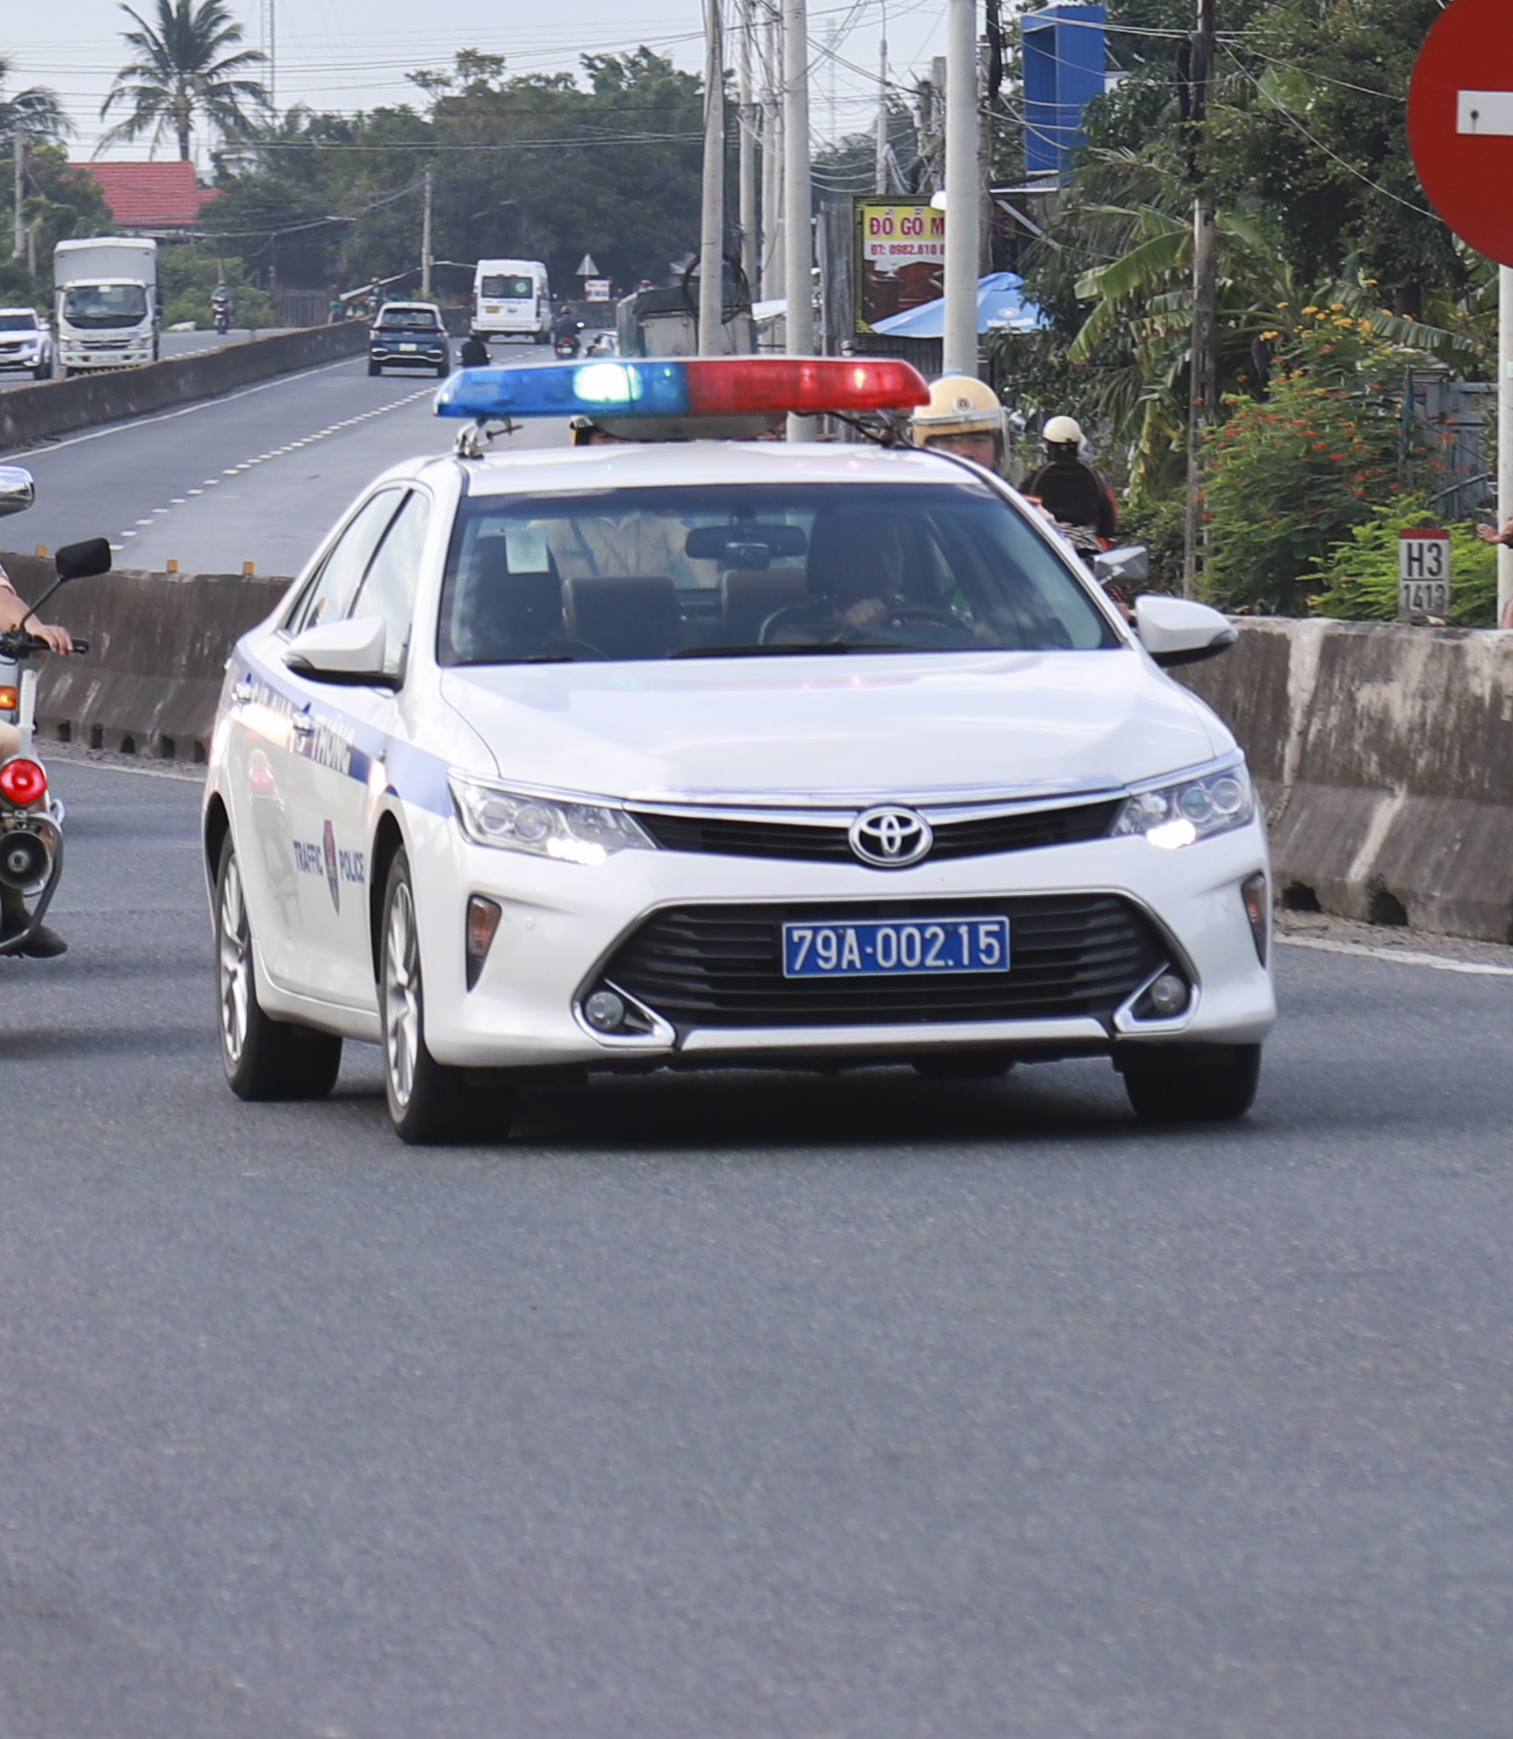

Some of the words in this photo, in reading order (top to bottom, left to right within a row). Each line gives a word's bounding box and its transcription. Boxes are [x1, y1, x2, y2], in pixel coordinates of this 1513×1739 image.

[900, 207, 924, 236] GỖ
[1407, 542, 1443, 577] H3
[293, 840, 324, 877] TRAFFIC
[339, 849, 365, 884] POLICE
[791, 923, 1001, 972] 79A-002.15
